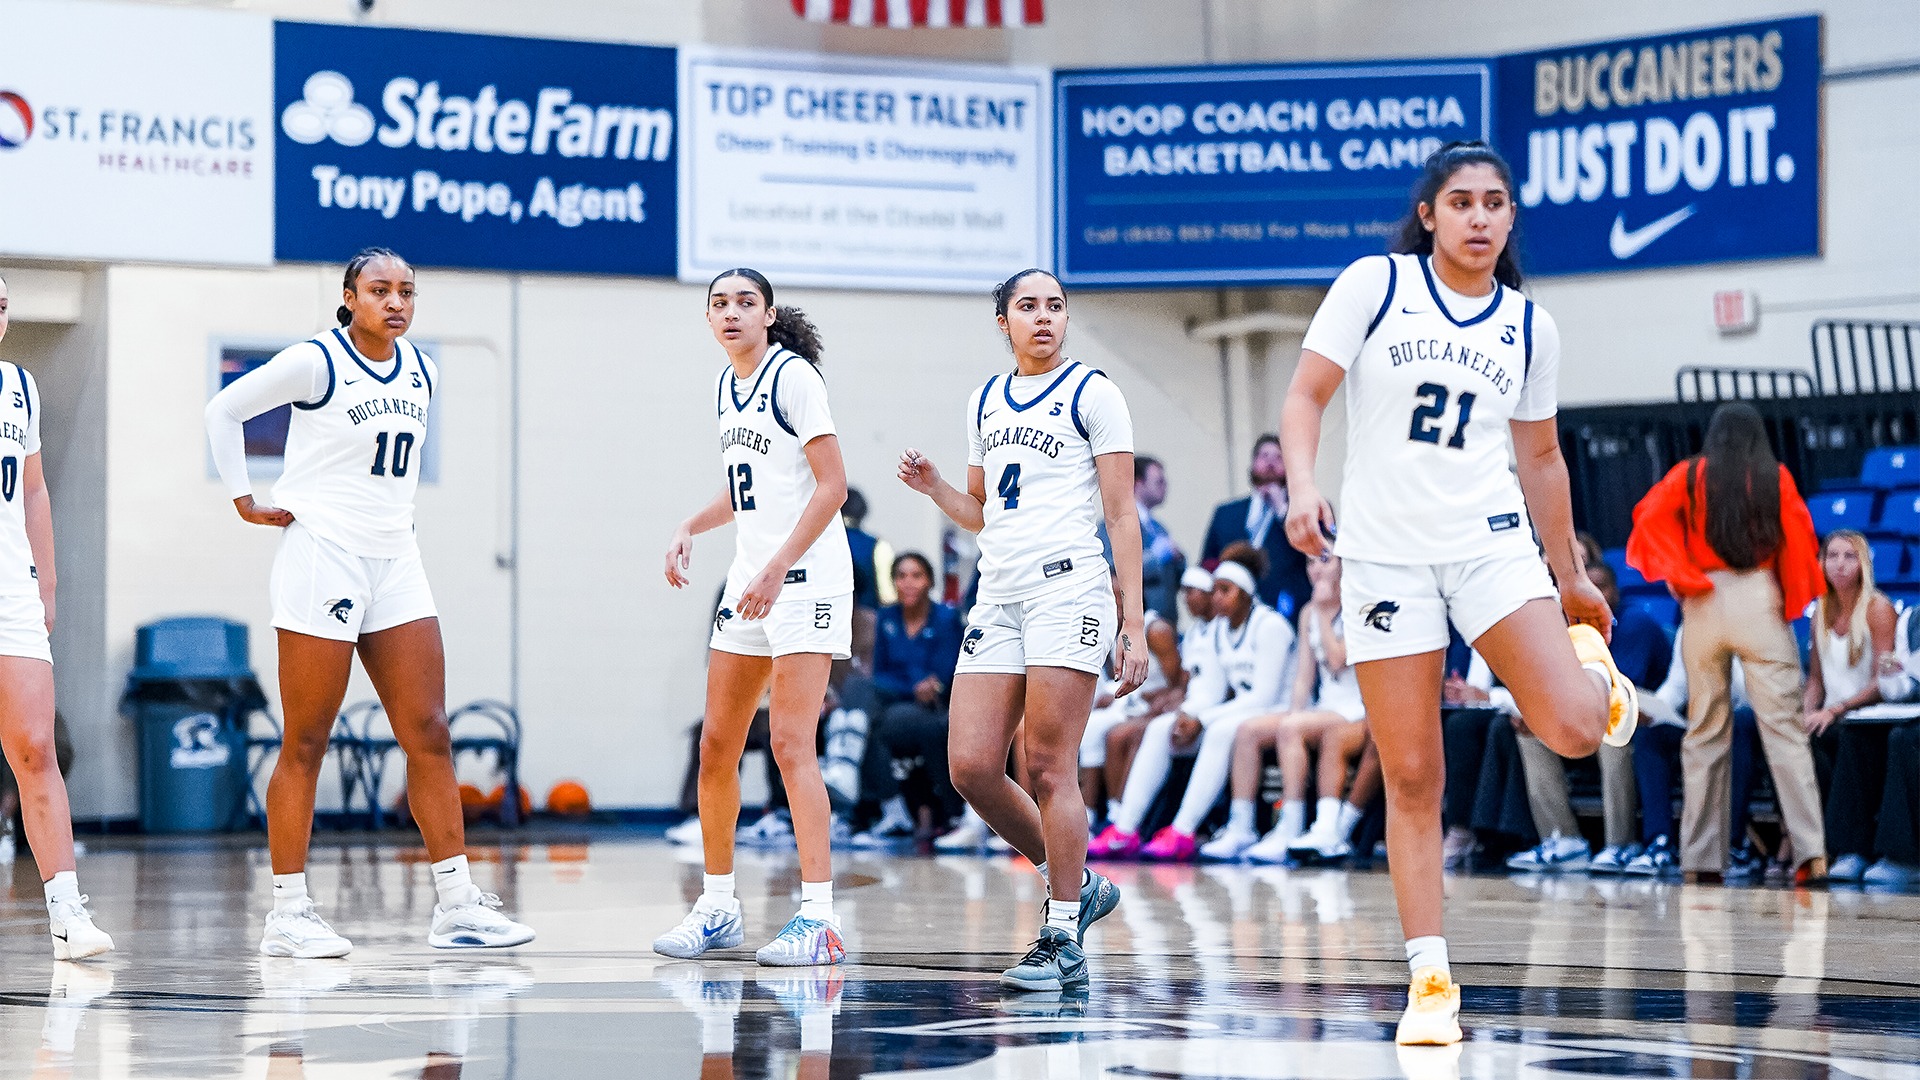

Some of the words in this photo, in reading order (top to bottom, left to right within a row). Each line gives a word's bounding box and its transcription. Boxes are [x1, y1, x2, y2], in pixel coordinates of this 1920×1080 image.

[1534, 30, 1783, 117] BUCCANEERS
[42, 106, 89, 142] ST.
[99, 109, 256, 151] FRANCIS
[705, 81, 773, 118] TOP
[784, 86, 896, 124] CHEER
[906, 92, 1027, 131] TALENT
[1081, 104, 1186, 138] HOOP
[1191, 100, 1318, 136] COACH
[1326, 96, 1465, 130] GARCIA
[98, 153, 255, 178] HEALTHCARE
[715, 131, 774, 155] Cheer
[782, 136, 859, 165] Training
[883, 141, 1016, 171] Choreography
[1104, 142, 1332, 177] BASKETBALL
[1520, 121, 1637, 208] JUST
[1645, 111, 1722, 195] DO
[1728, 105, 1795, 188] IT.
[312, 165, 406, 219] Tony
[413, 170, 522, 223] Pope,
[529, 178, 647, 227] Agent
[1388, 339, 1513, 395] BUCCANEERS
[1408, 381, 1477, 450] 21
[370, 432, 415, 477] 10
[727, 462, 756, 512] 12
[997, 463, 1021, 511] 4
[814, 602, 832, 629] CSU
[1080, 615, 1100, 647] CSU
